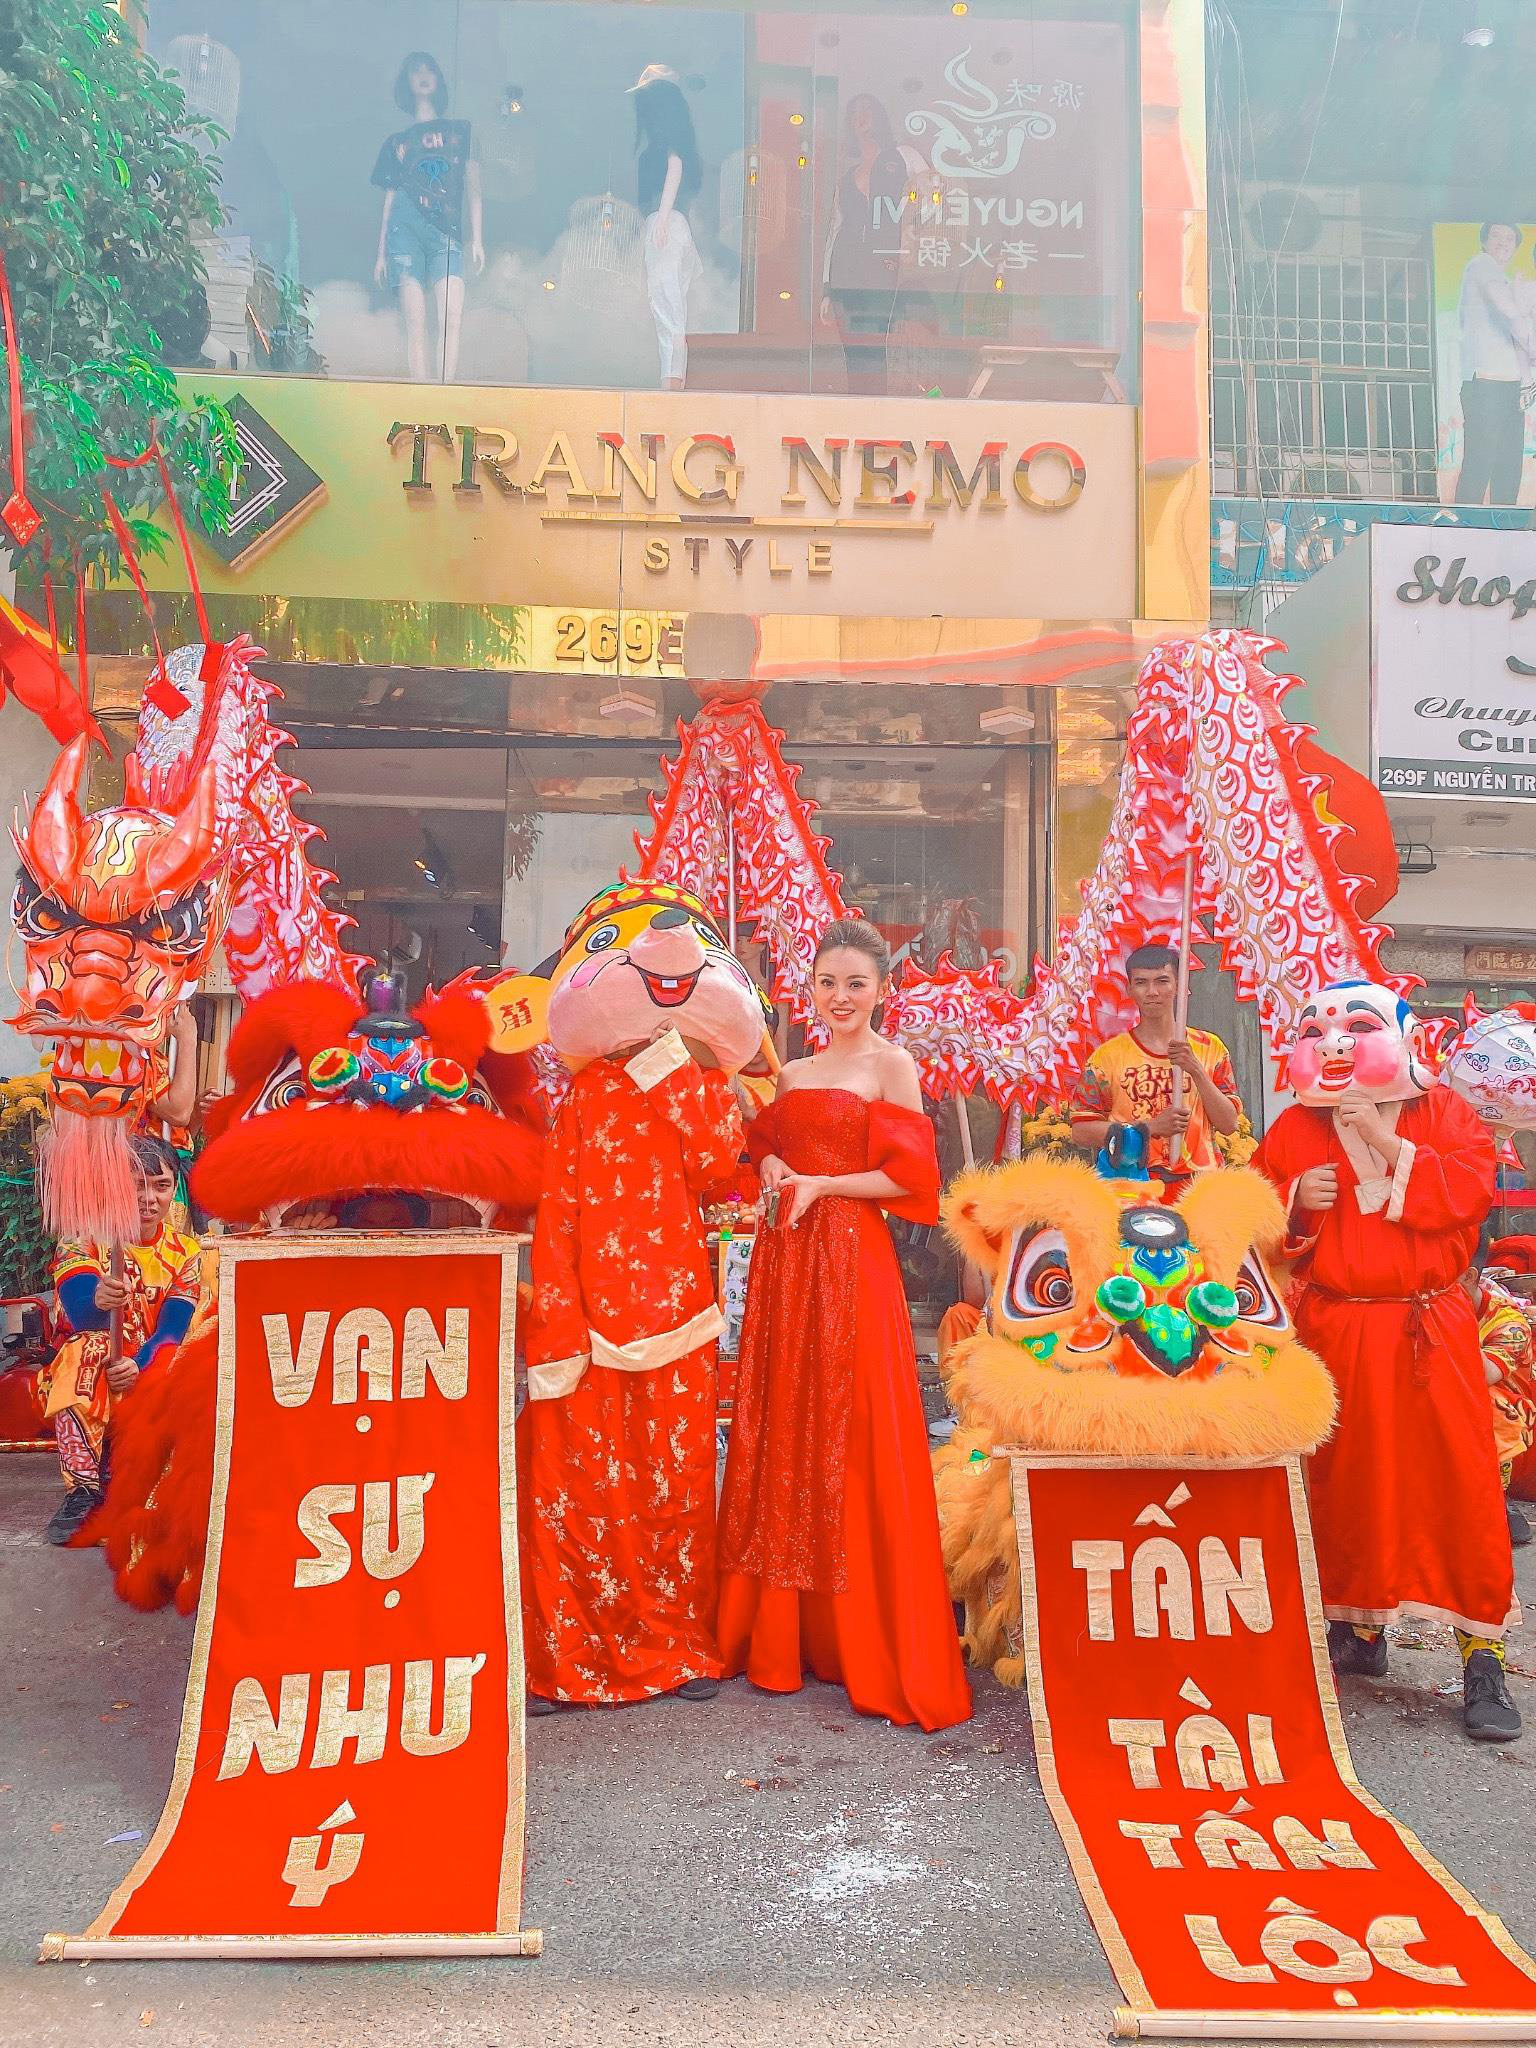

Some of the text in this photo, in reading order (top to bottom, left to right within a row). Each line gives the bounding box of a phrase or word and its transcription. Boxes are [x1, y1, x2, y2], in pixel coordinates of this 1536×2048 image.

[386, 421, 1087, 512] TRANG NEMO
[643, 537, 833, 577] STYLE
[556, 615, 684, 667] 269E
[1414, 696, 1536, 727] Chuy
[1382, 767, 1427, 787] 269F
[1433, 764, 1508, 790] NGUYỄN
[262, 1306, 470, 1434] VẠN
[293, 1471, 436, 1609] SỰ
[1071, 1481, 1274, 1642] TẤN
[217, 1652, 486, 1783] NHƯ
[1107, 1676, 1290, 1793] TÀI
[282, 1799, 365, 1909] Ý
[1118, 1796, 1381, 1872] TẤN
[1183, 1896, 1467, 2008] LỘC
